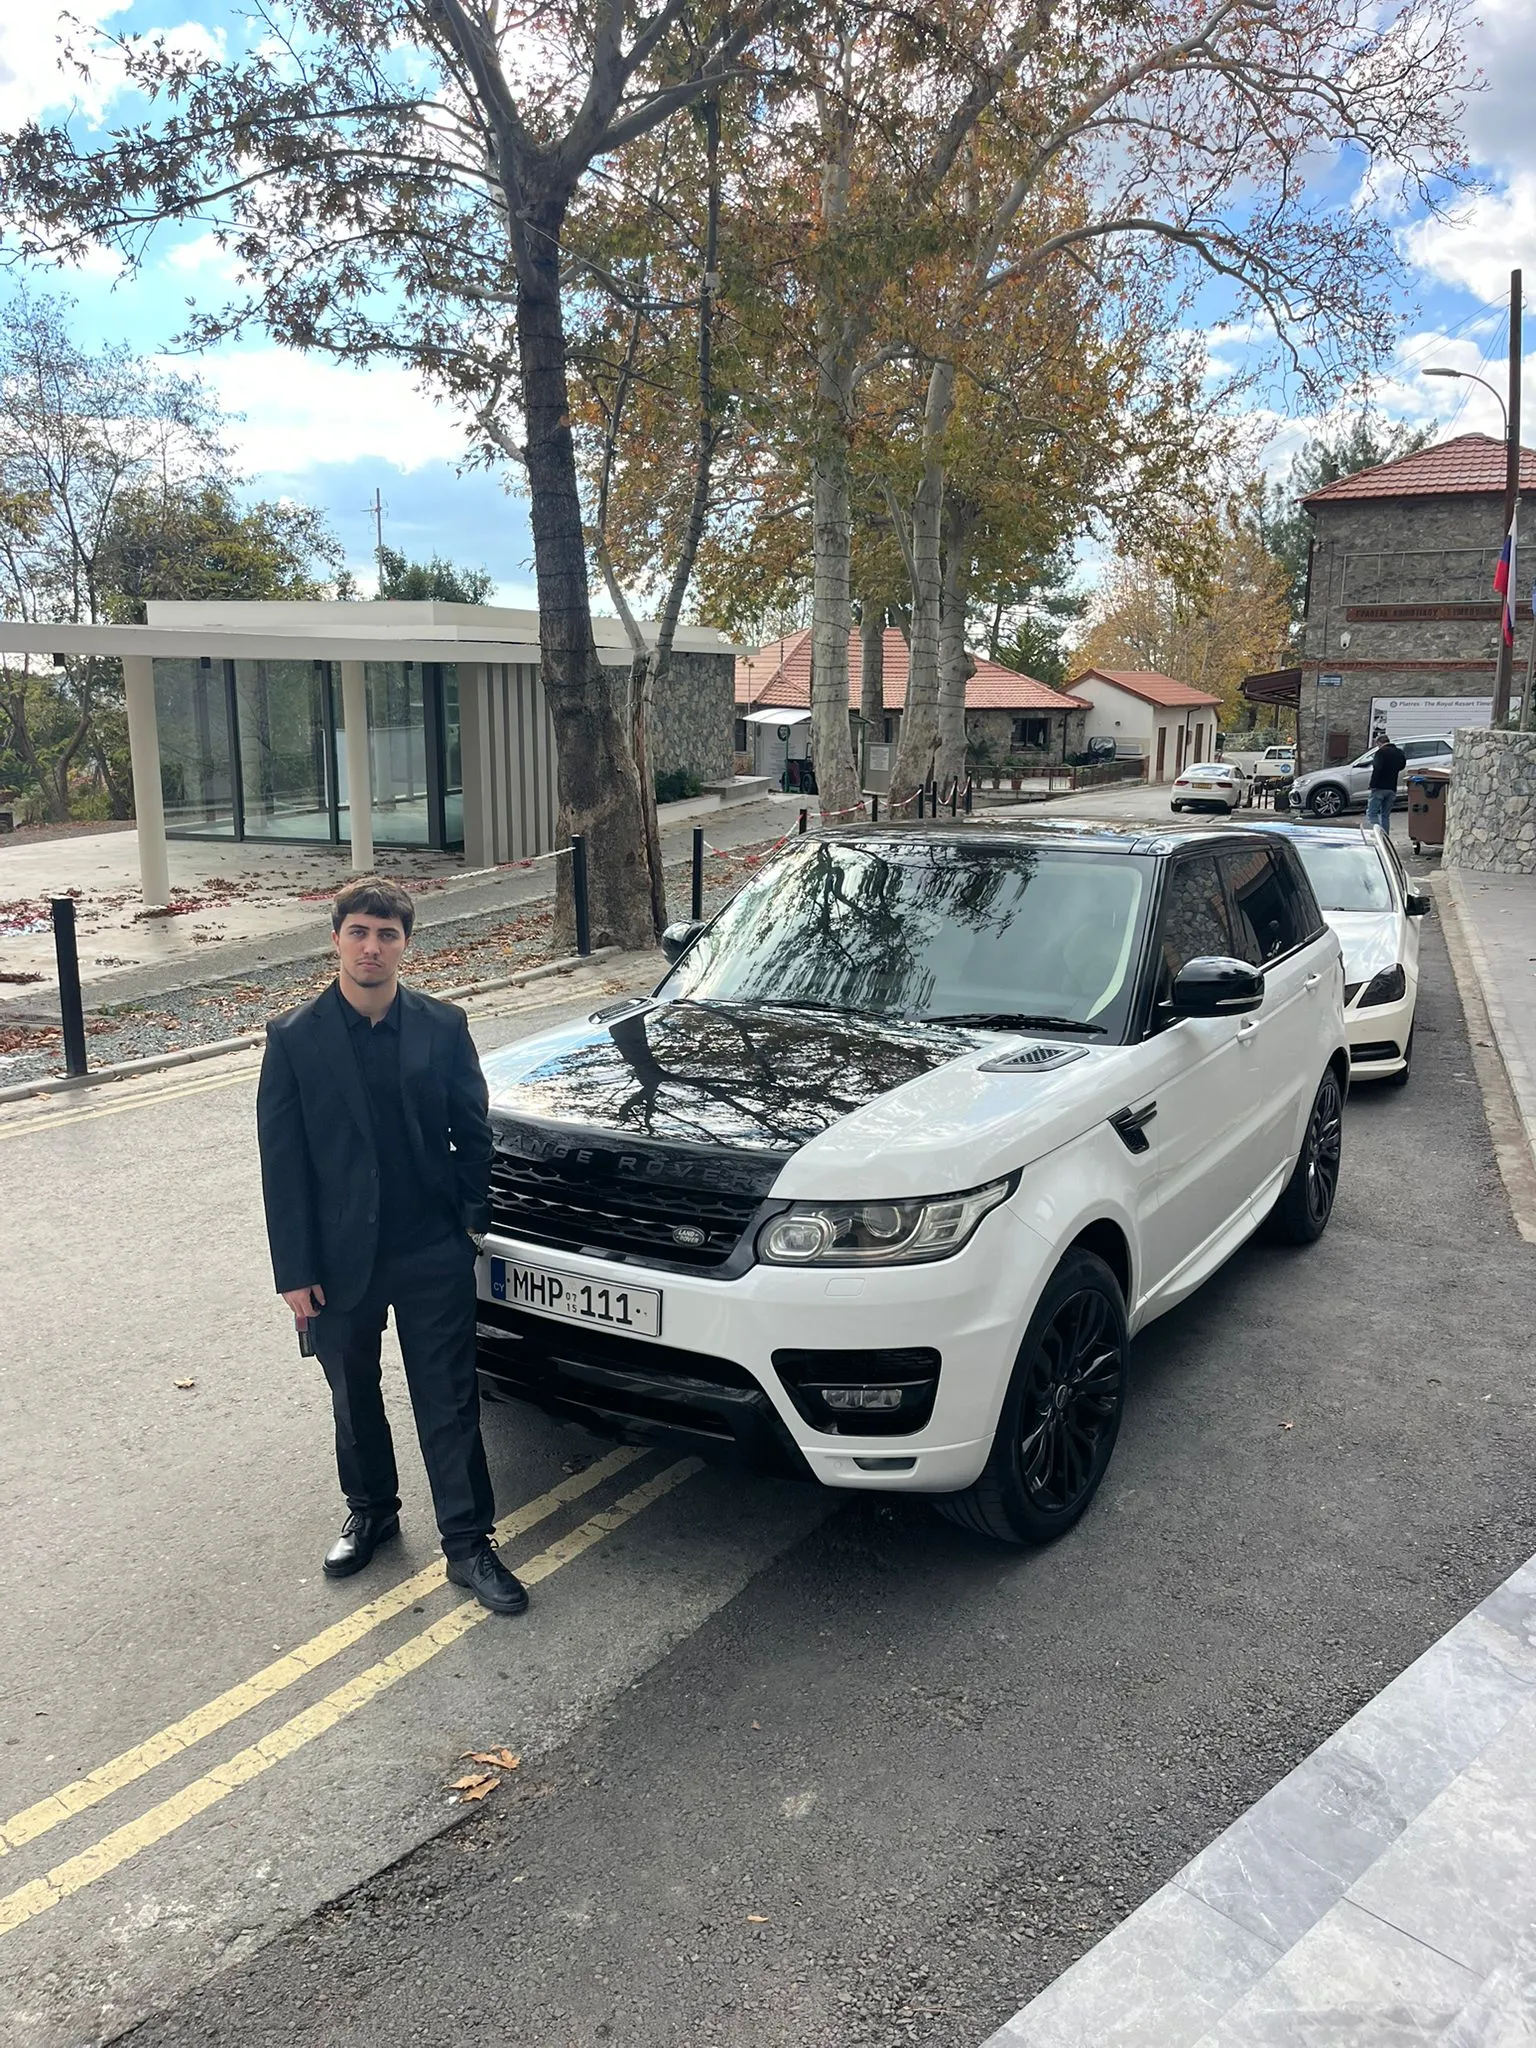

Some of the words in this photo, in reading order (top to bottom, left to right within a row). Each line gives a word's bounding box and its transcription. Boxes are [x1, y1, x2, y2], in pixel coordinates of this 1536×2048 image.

[1436, 700, 1454, 709] Royal
[493, 1129, 594, 1164] RANGE
[618, 1155, 756, 1189] ROVER
[678, 1229, 695, 1238] LAND
[679, 1234, 699, 1244] ROVER
[493, 1282, 505, 1293] CY
[513, 1268, 563, 1308] MHP
[580, 1285, 633, 1326] 111
[565, 1291, 578, 1302] 07
[566, 1302, 578, 1314] 15
